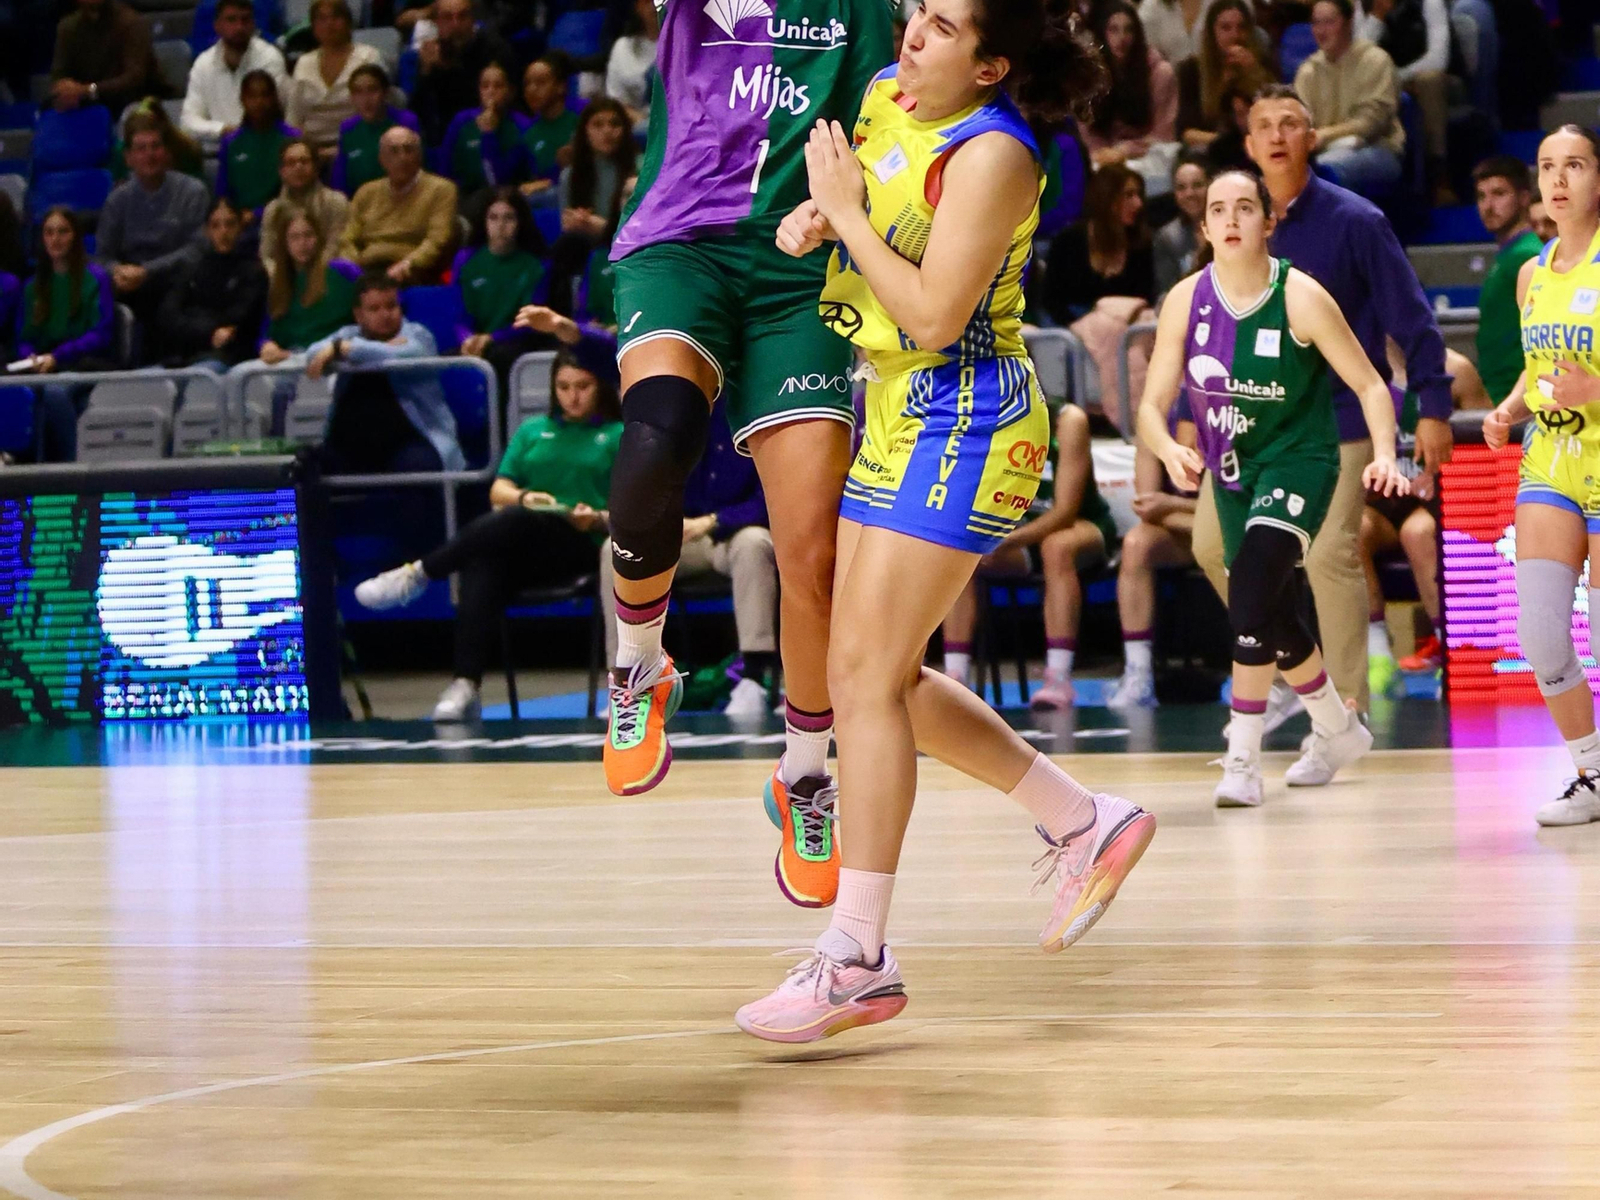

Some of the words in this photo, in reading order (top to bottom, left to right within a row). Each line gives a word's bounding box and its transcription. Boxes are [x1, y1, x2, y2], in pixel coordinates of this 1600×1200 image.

[766, 17, 847, 46] Unicaja
[728, 63, 811, 120] Mijas
[749, 139, 770, 194] 1
[1224, 378, 1286, 401] Unicaja
